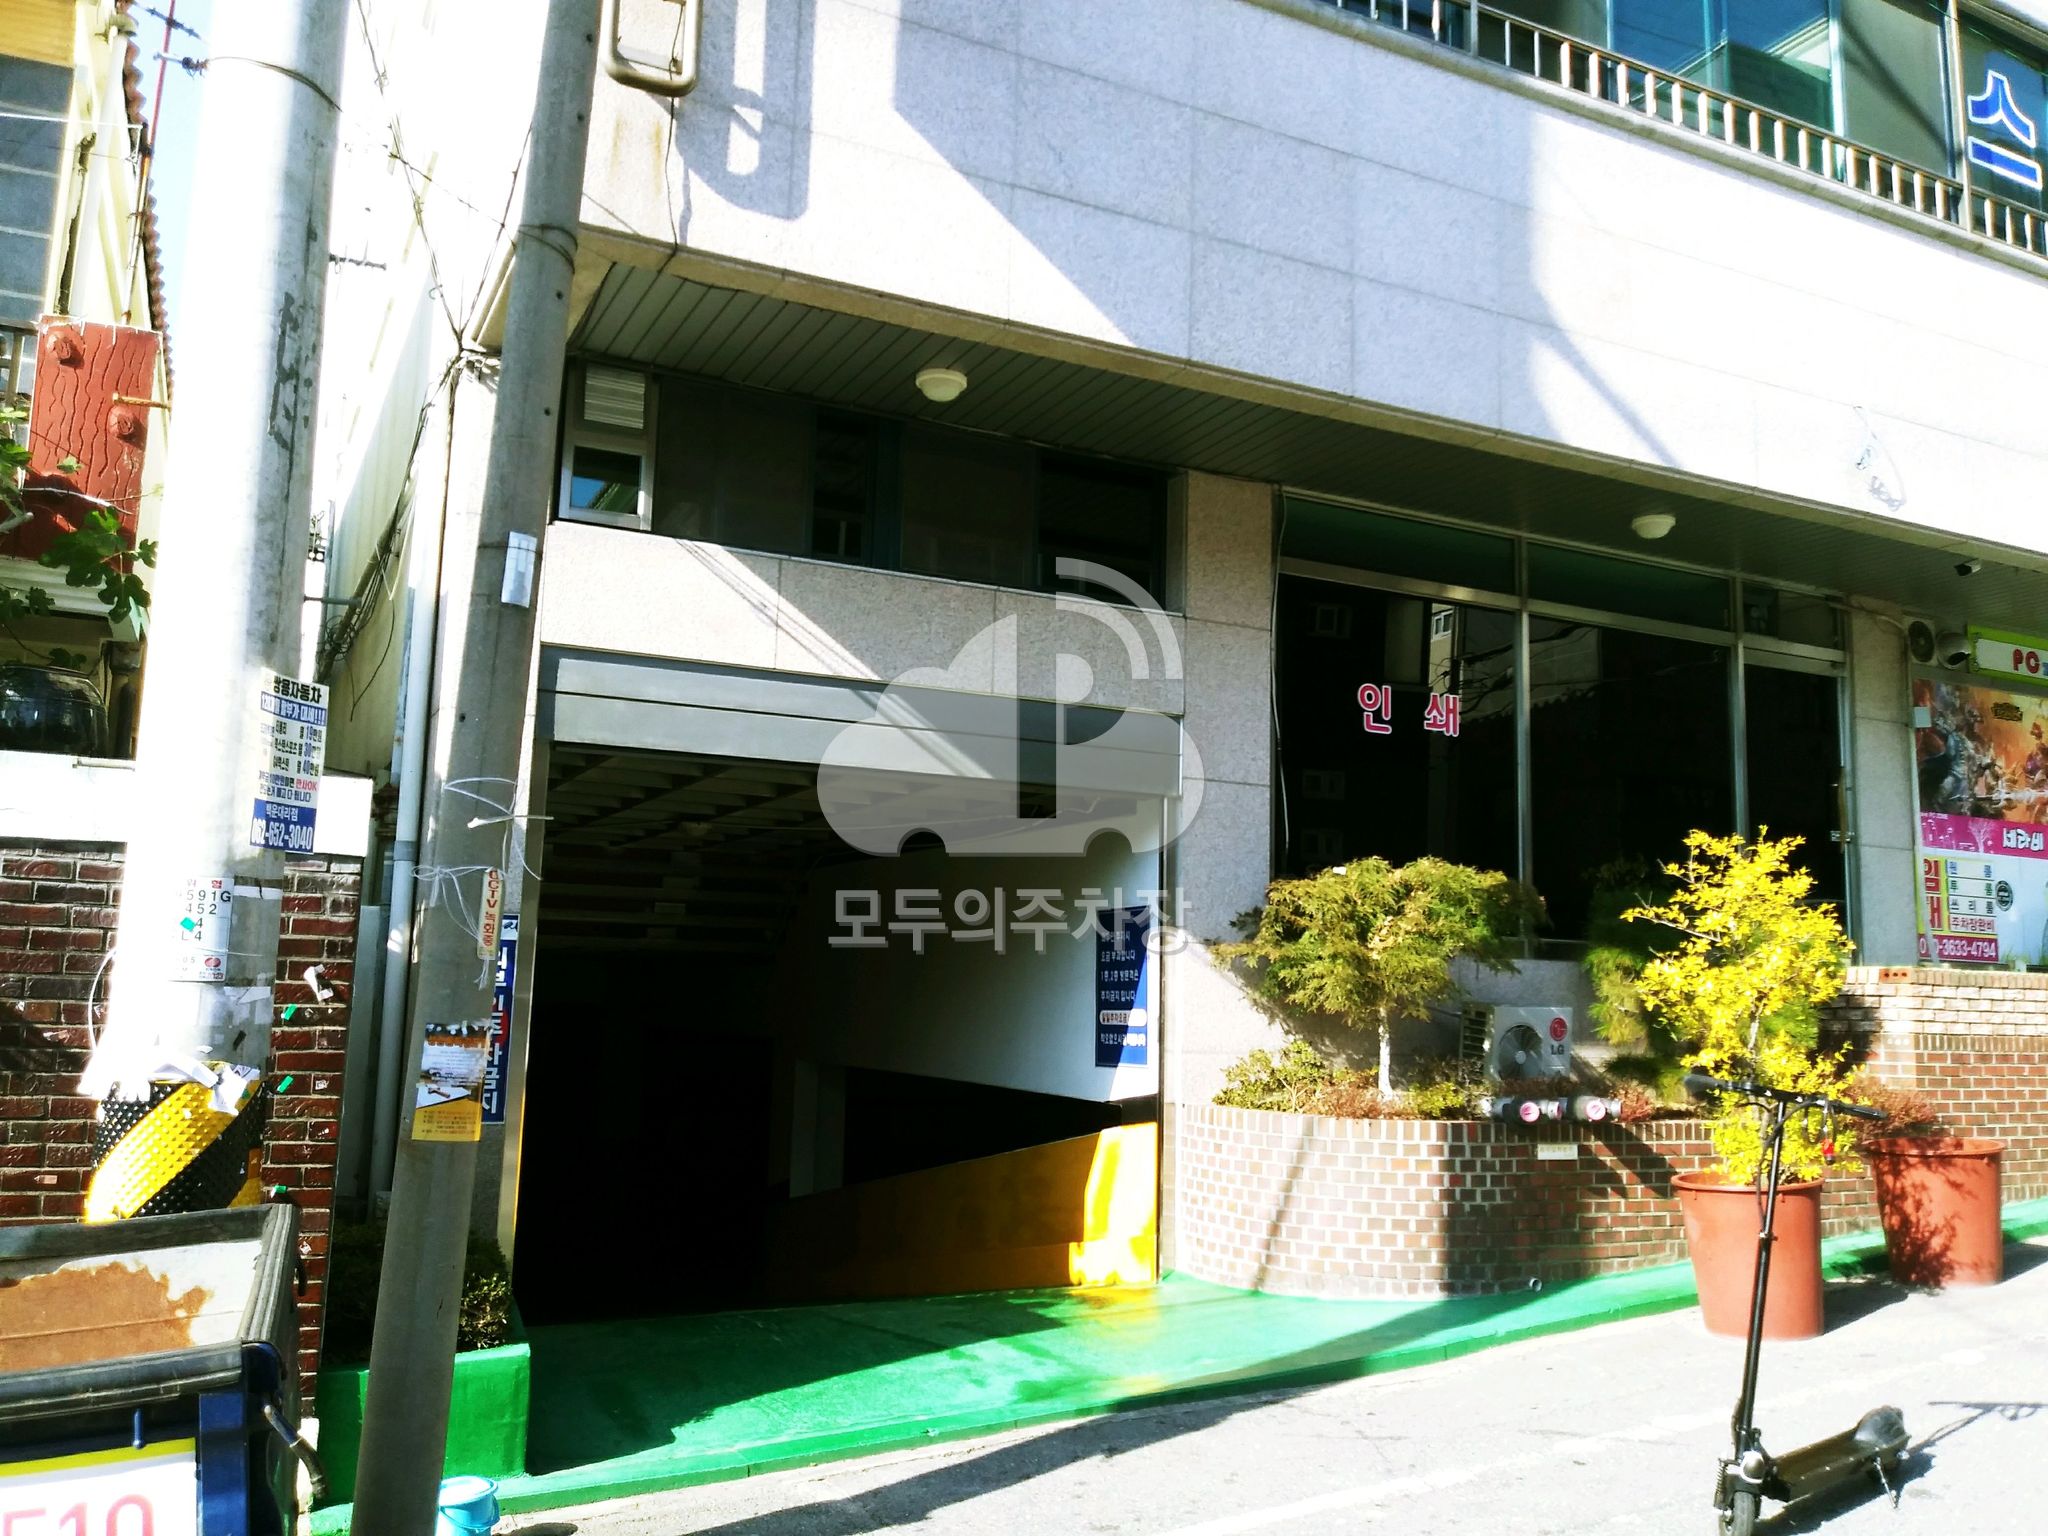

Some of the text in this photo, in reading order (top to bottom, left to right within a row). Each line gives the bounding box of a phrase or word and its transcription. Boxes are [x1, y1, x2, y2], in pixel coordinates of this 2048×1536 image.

[273, 675, 322, 704] 쌍용자동차
[266, 804, 299, 821] 백운대리점
[251, 818, 314, 850] 062-652-3040
[1951, 917, 1995, 931] 주차장완비
[1551, 1044, 1565, 1055] LG
